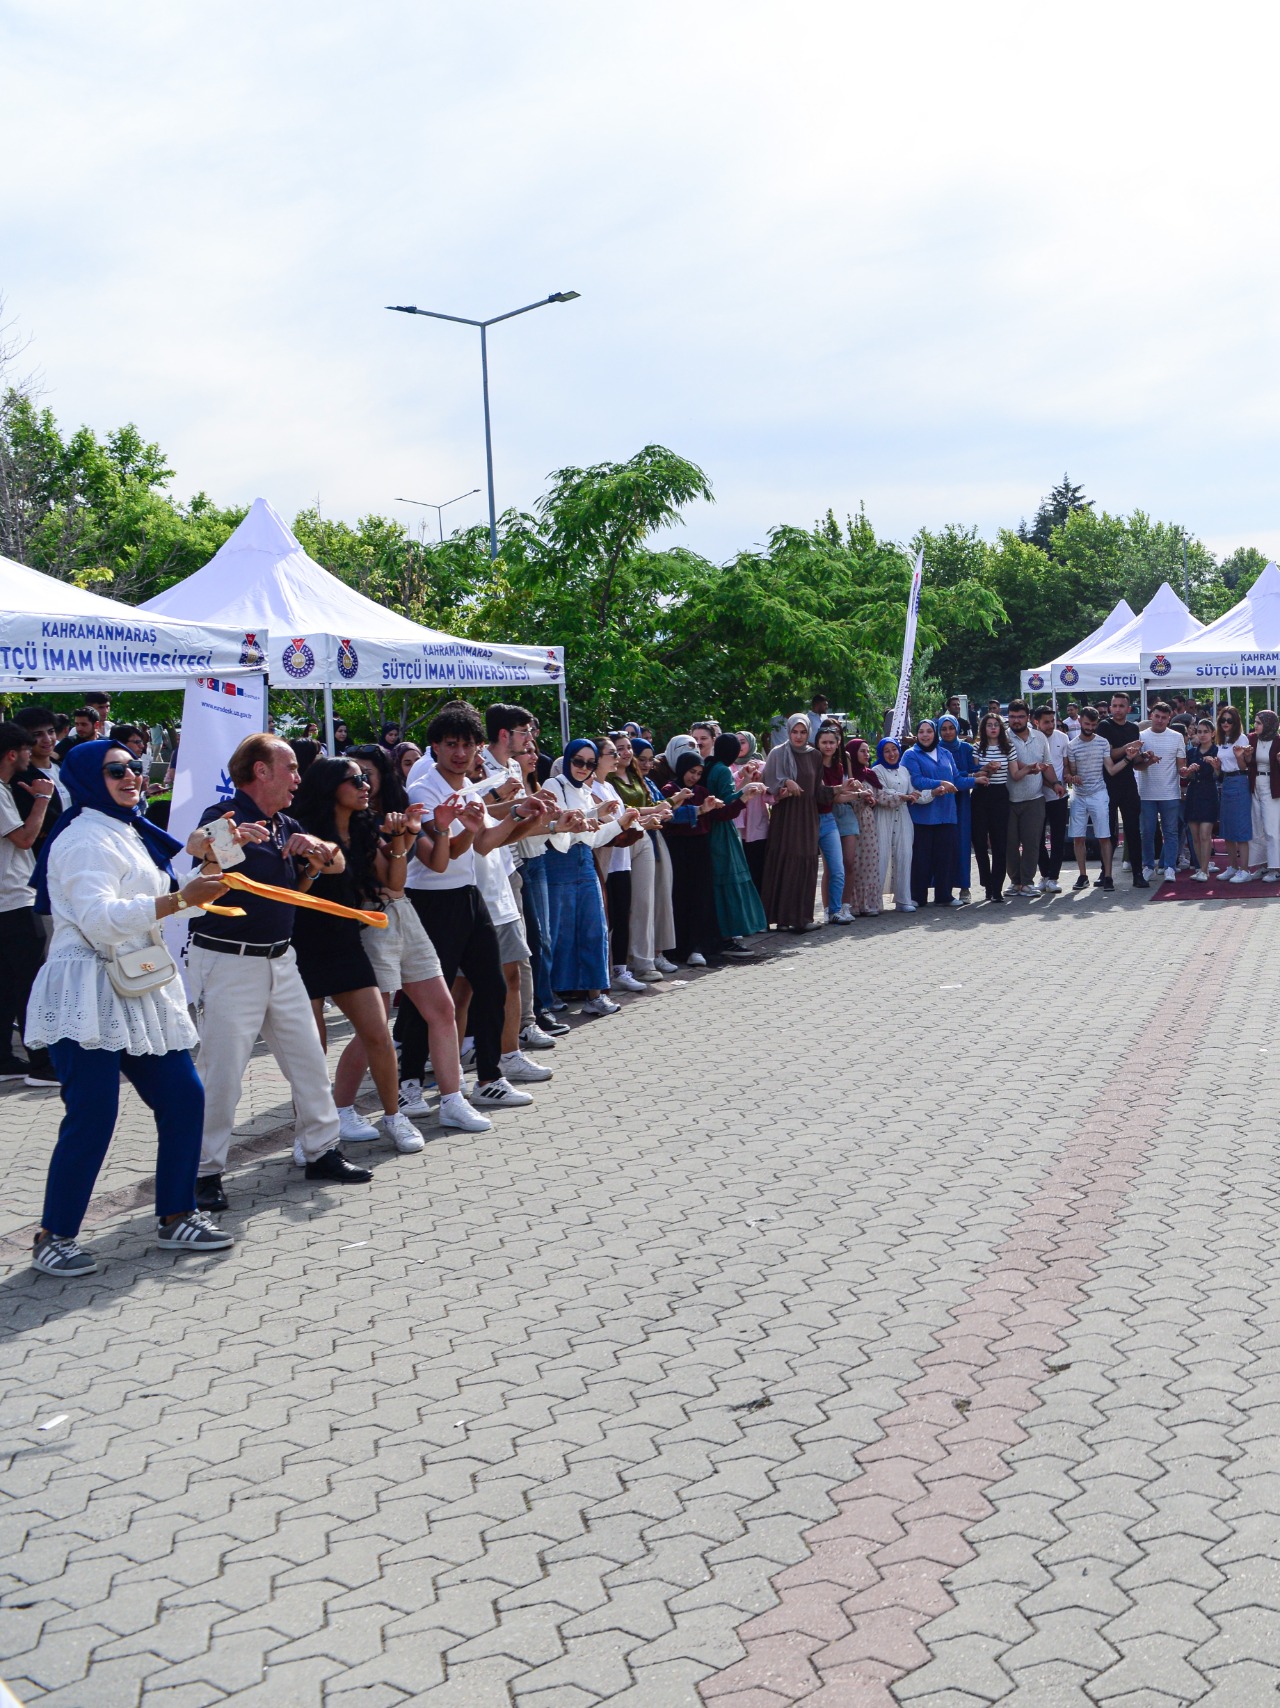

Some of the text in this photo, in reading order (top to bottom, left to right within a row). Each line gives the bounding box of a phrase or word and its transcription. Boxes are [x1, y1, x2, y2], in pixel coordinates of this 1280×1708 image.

[42, 622, 157, 646] KAHRAMANMARAŞ
[0, 641, 215, 675] TÇÜ İMAM ÜNİVERSİTESİ
[422, 644, 493, 660] KAHRAMANMARAŞ
[382, 658, 422, 684] SÜTÇÜ
[425, 659, 456, 680] İMAM
[458, 659, 530, 681] ÜNİVERSİTESİ
[1100, 674, 1137, 687] SÜTÇÜ
[1196, 664, 1238, 678] SÜTÇÜ
[1242, 663, 1277, 676] İMAM
